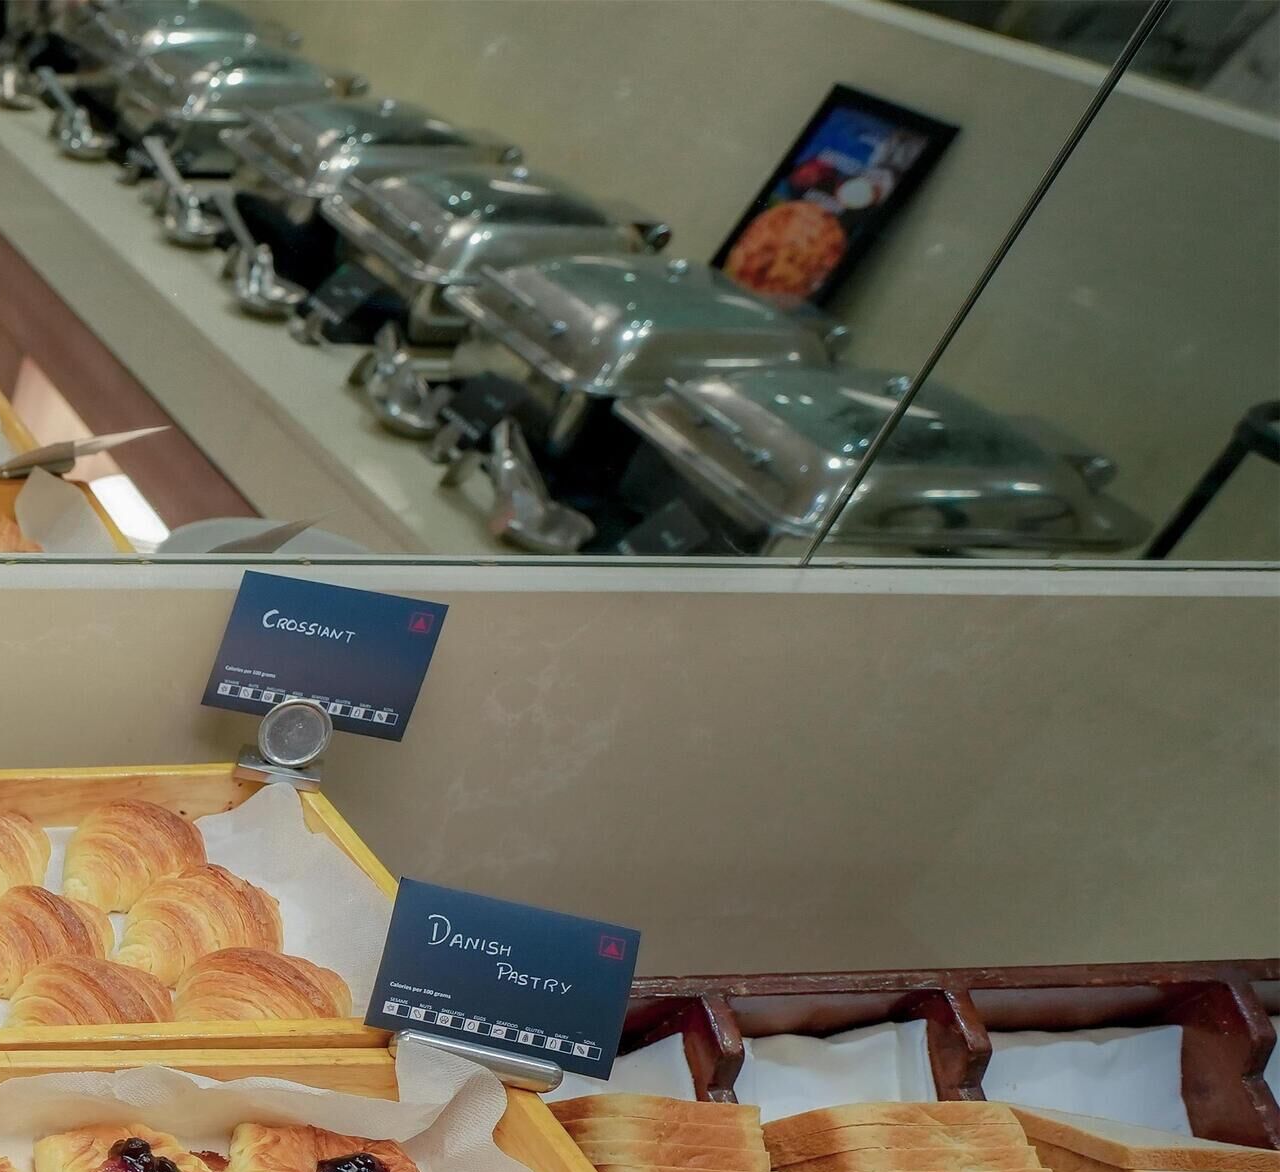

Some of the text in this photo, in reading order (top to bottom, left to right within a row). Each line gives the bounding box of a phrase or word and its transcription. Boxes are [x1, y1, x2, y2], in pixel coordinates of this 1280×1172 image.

[262, 609, 356, 644] CROSSIANT
[427, 914, 512, 957] DANISH
[390, 981, 411, 991] Calories
[496, 962, 572, 996] PASTRY
